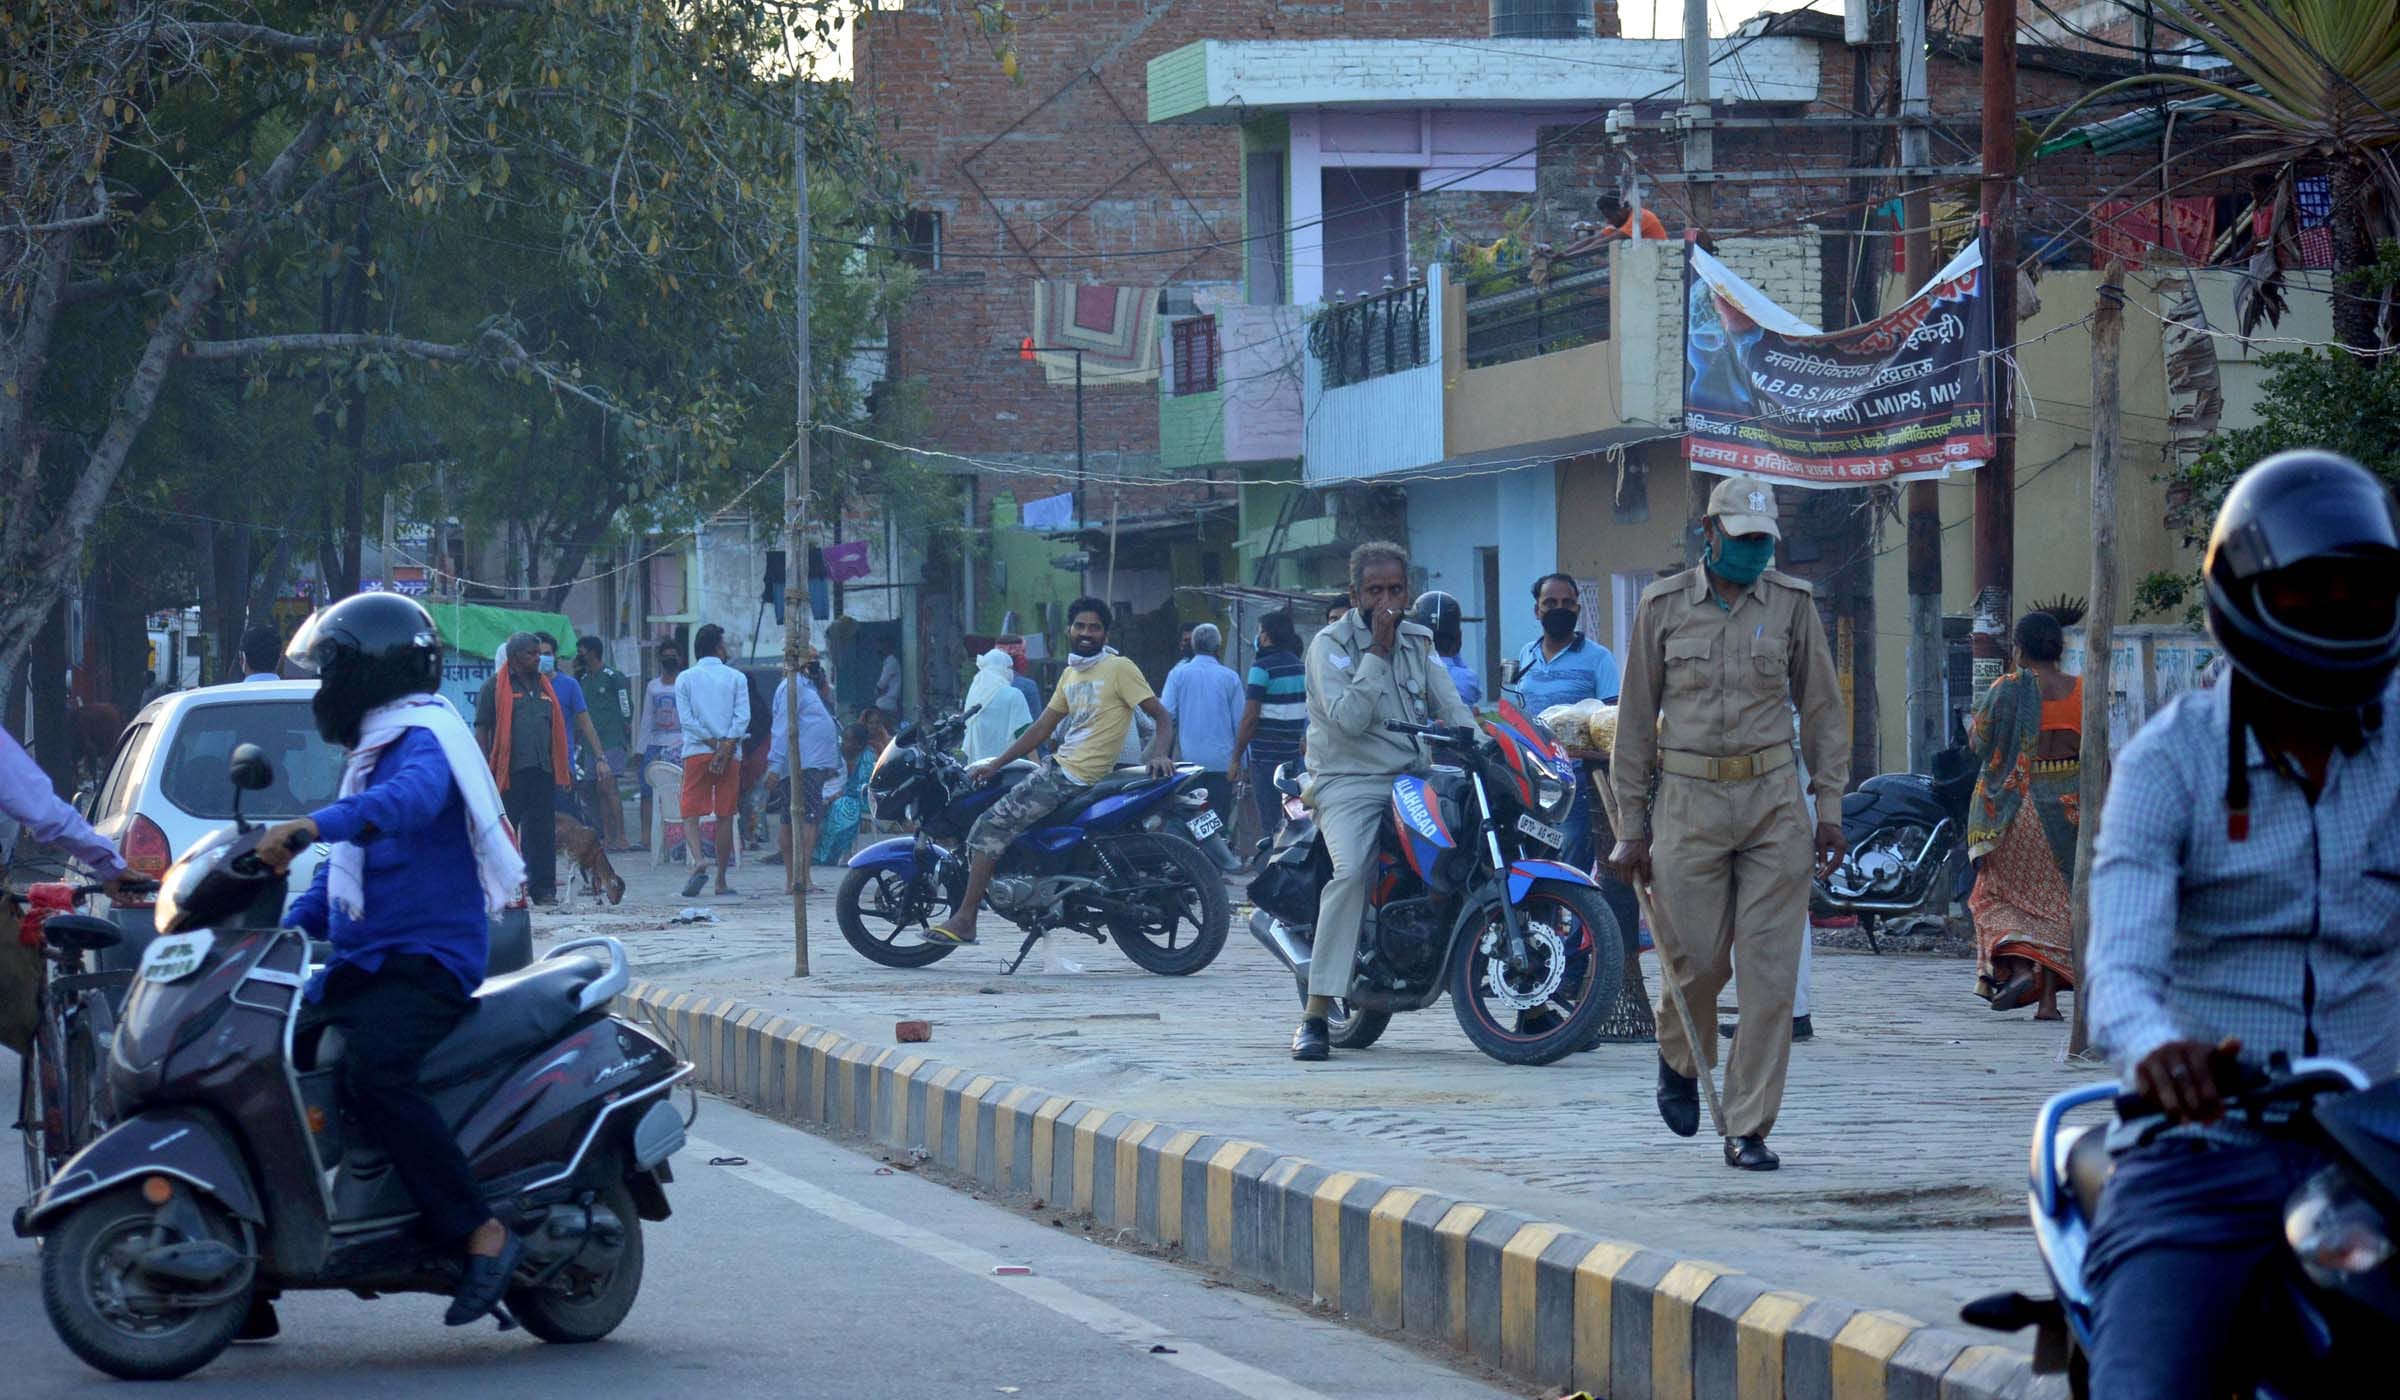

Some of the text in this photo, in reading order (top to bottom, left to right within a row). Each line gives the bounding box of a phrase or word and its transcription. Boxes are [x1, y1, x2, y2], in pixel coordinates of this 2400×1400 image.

[1765, 350, 1872, 378] मनोचिकित्सक
[1902, 313, 1964, 350] इकेट्री)
[1862, 390, 1926, 420] LMIPS,
[1393, 778, 1437, 838] ALLAHABAD
